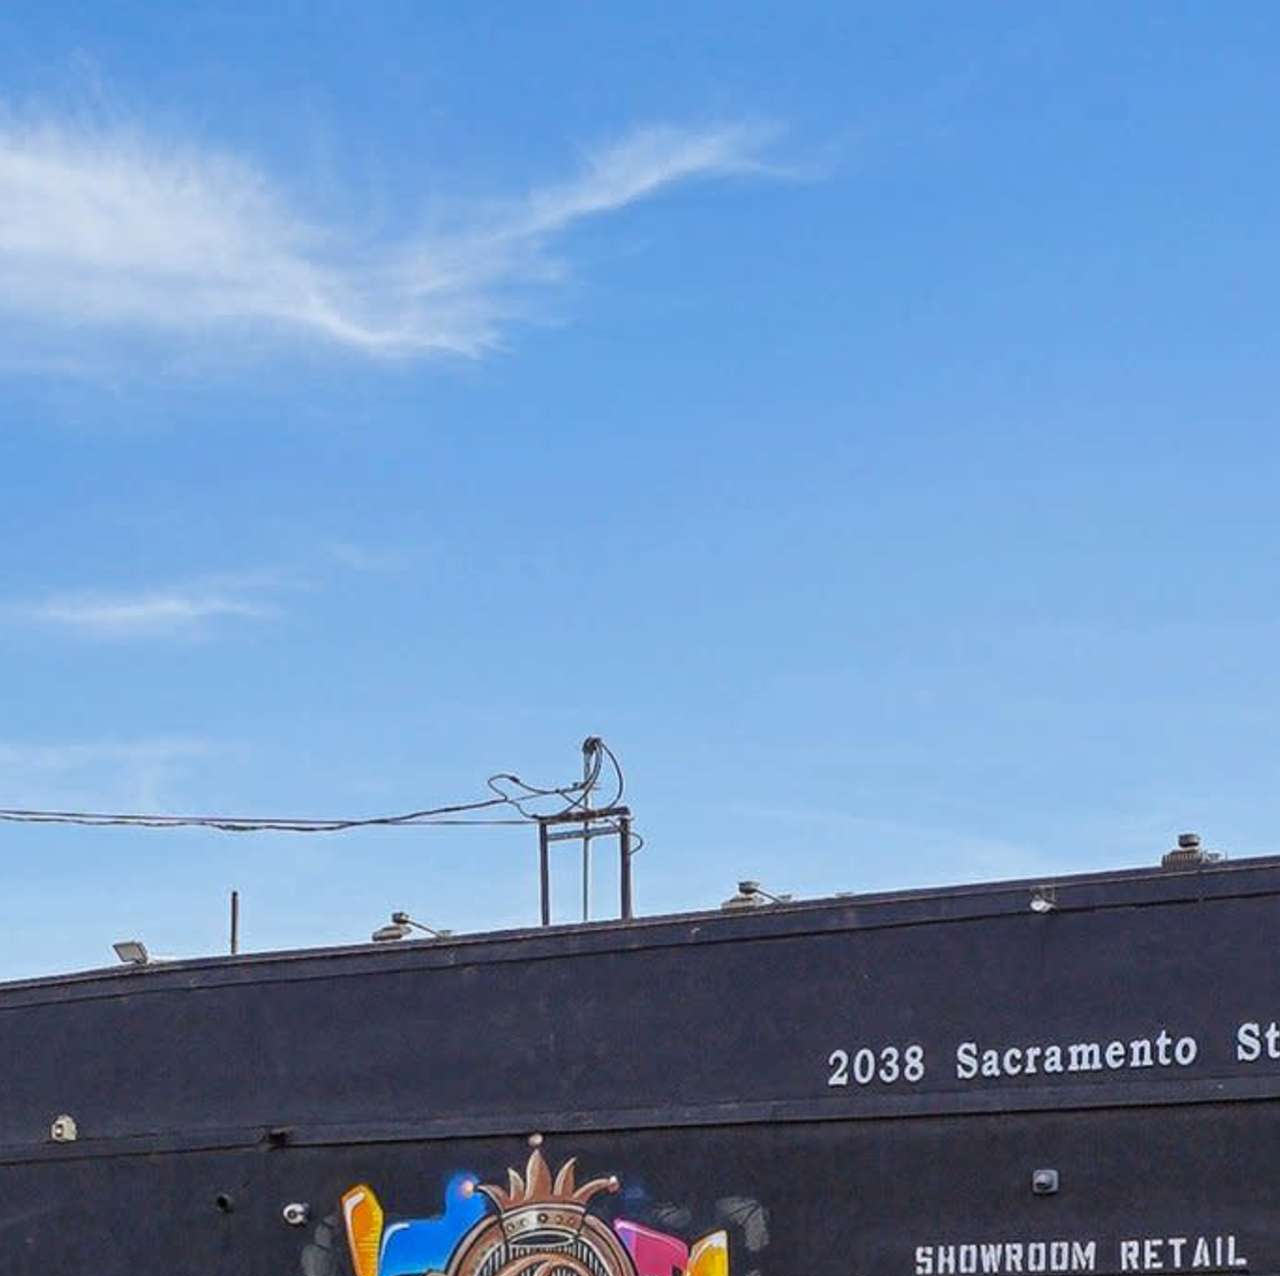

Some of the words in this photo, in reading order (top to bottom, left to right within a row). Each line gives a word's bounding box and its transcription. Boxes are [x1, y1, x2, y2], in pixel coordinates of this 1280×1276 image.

[828, 1046, 925, 1086] 2038
[957, 1029, 1198, 1079] Sacramento
[915, 1240, 1097, 1275] SHOWROOM
[1121, 1236, 1247, 1270] RETAIL
